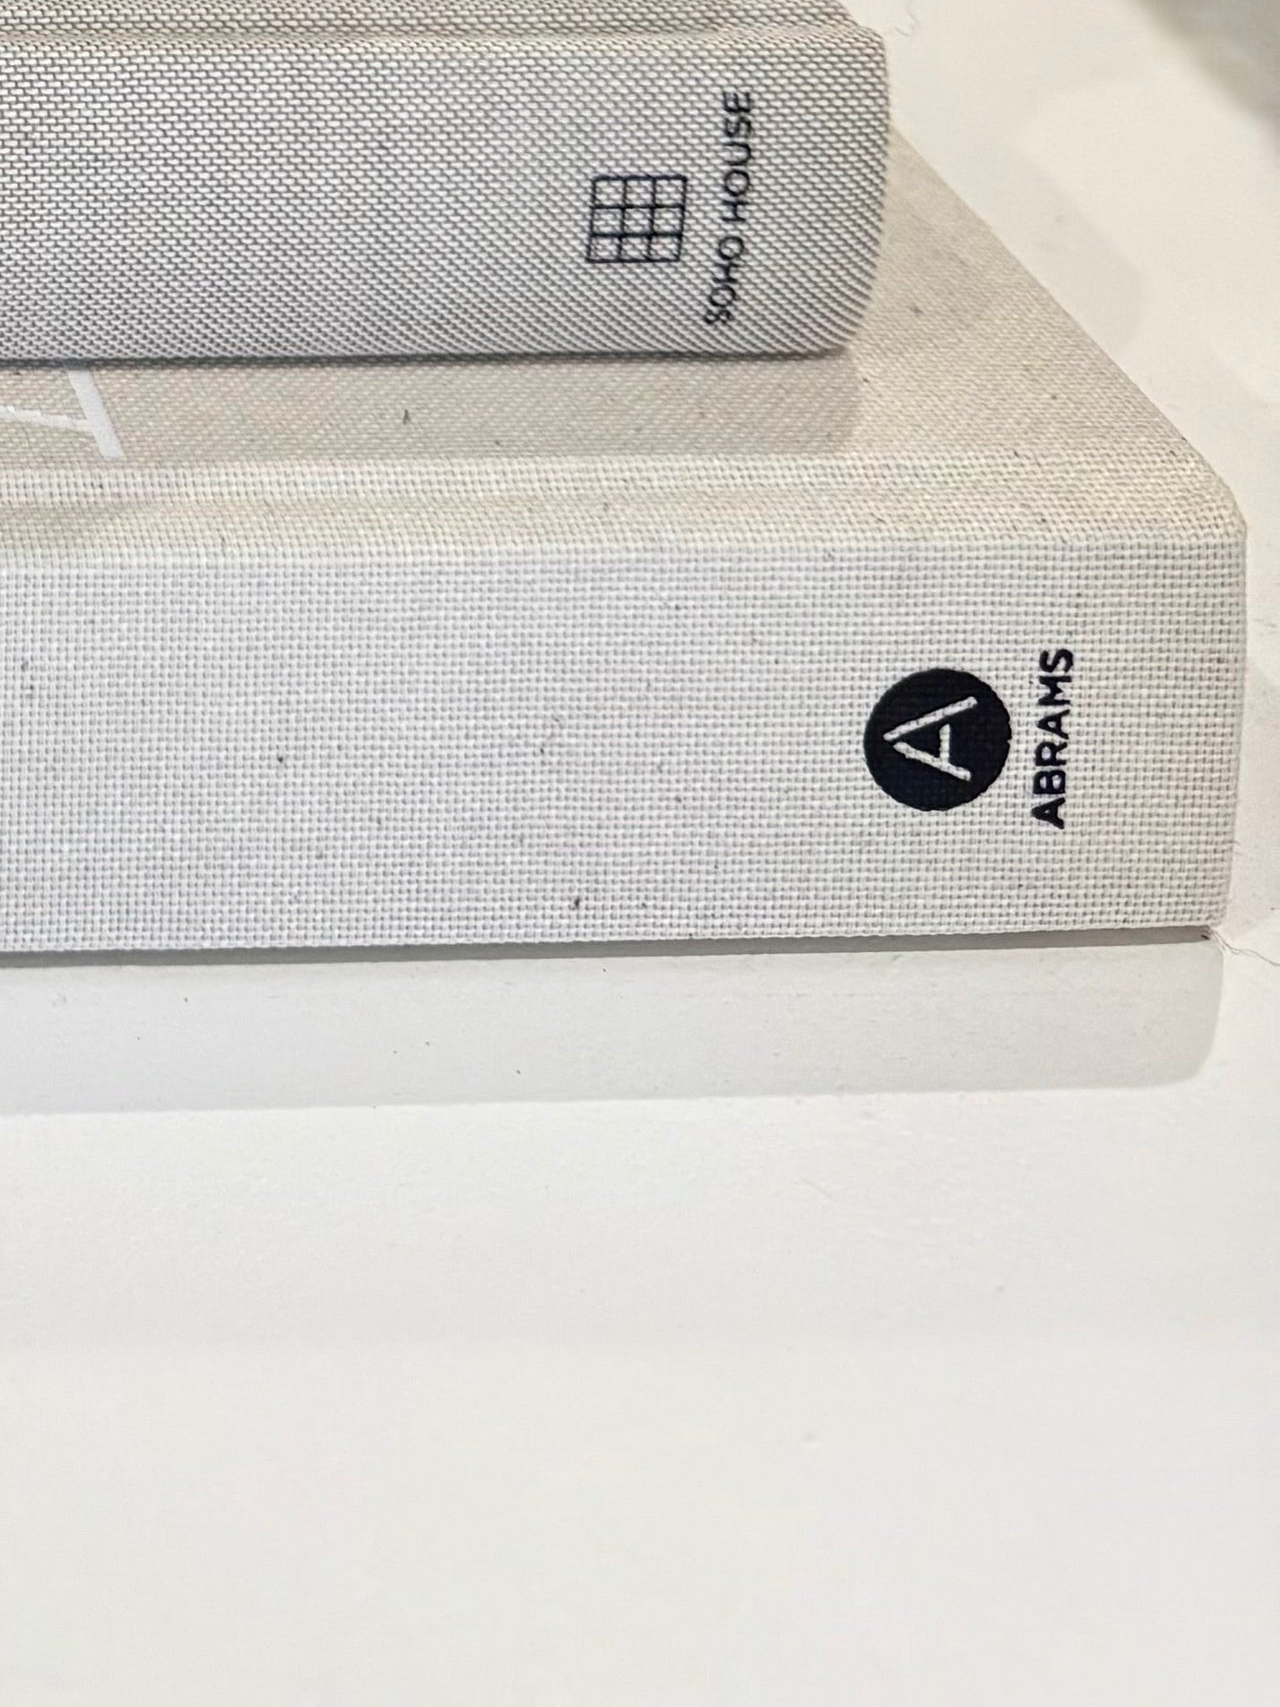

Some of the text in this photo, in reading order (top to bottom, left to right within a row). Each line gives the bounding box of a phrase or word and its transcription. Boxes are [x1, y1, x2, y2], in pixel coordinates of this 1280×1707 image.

[704, 90, 753, 327] SOHO HOUSE
[1030, 648, 1074, 830] ABRAMS
